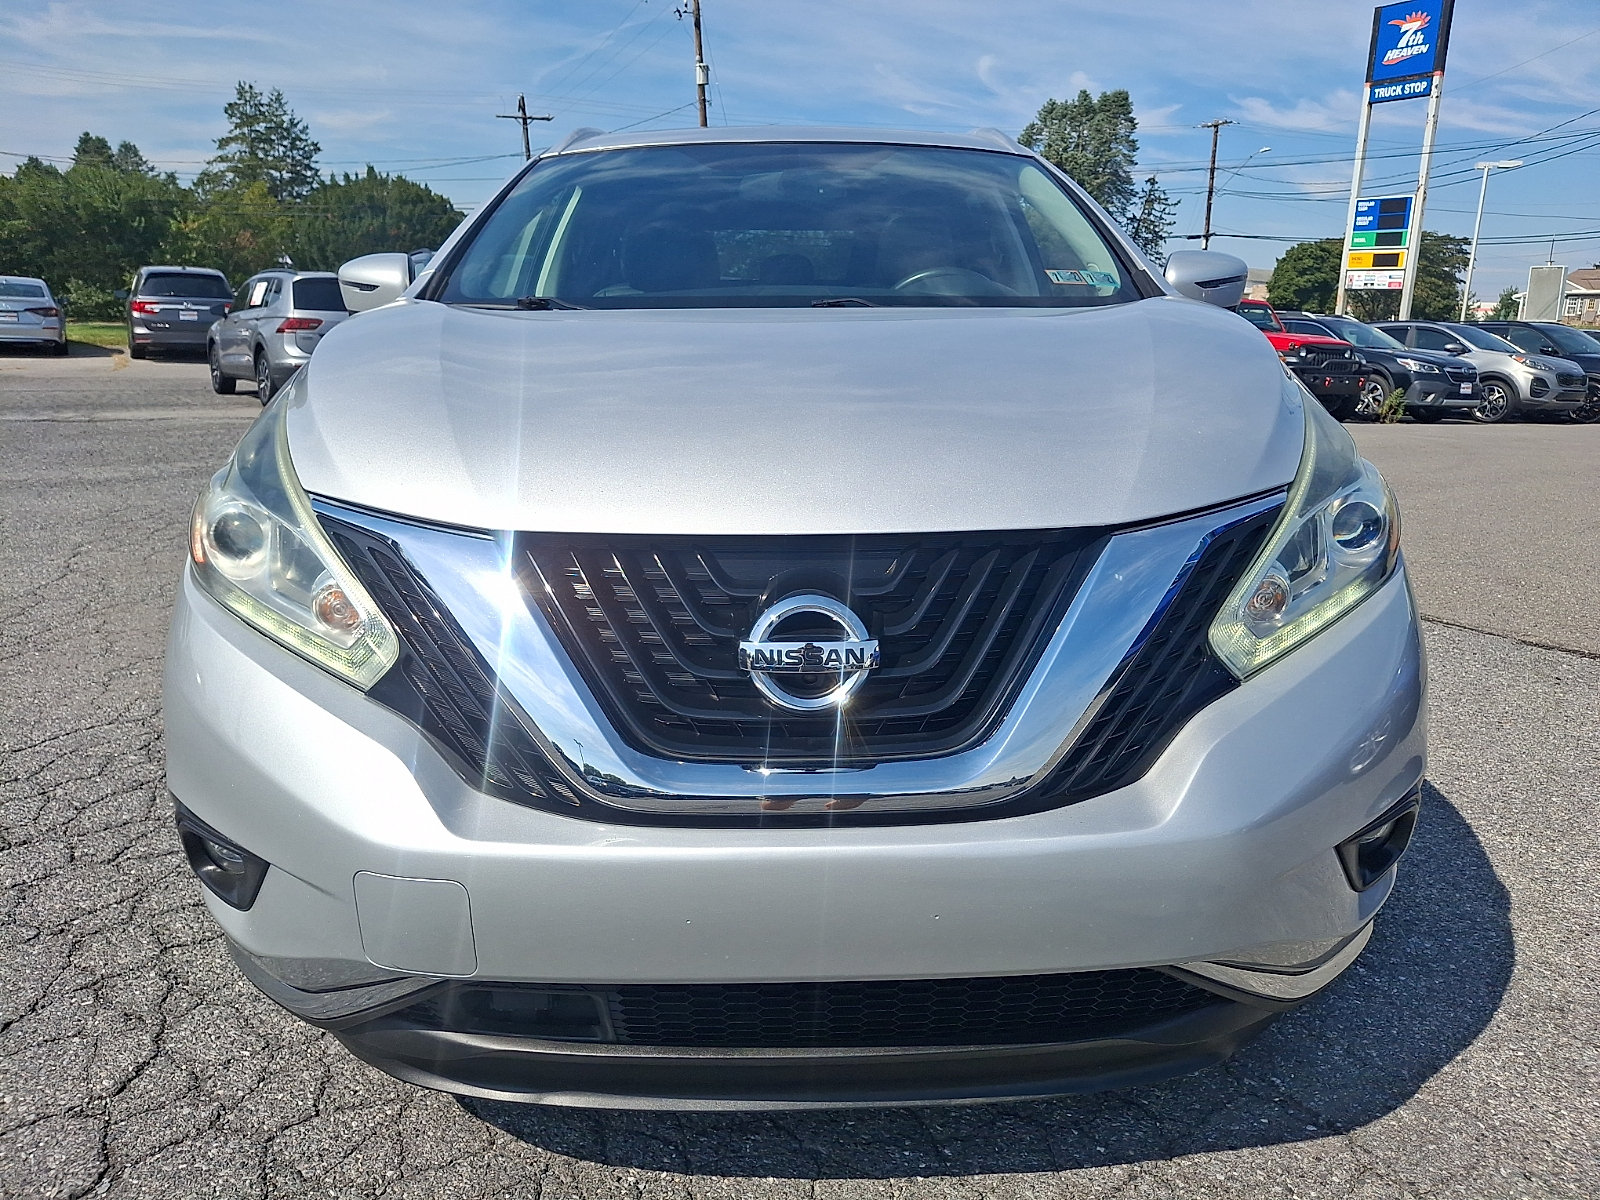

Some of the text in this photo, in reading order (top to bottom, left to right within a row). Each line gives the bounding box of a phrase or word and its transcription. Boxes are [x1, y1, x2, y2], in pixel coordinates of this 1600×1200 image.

[1397, 21, 1424, 48] 7th
[1383, 44, 1430, 62] HEAVEN
[1374, 81, 1428, 98] TRUCK STOP
[754, 647, 865, 666] NISSAN
